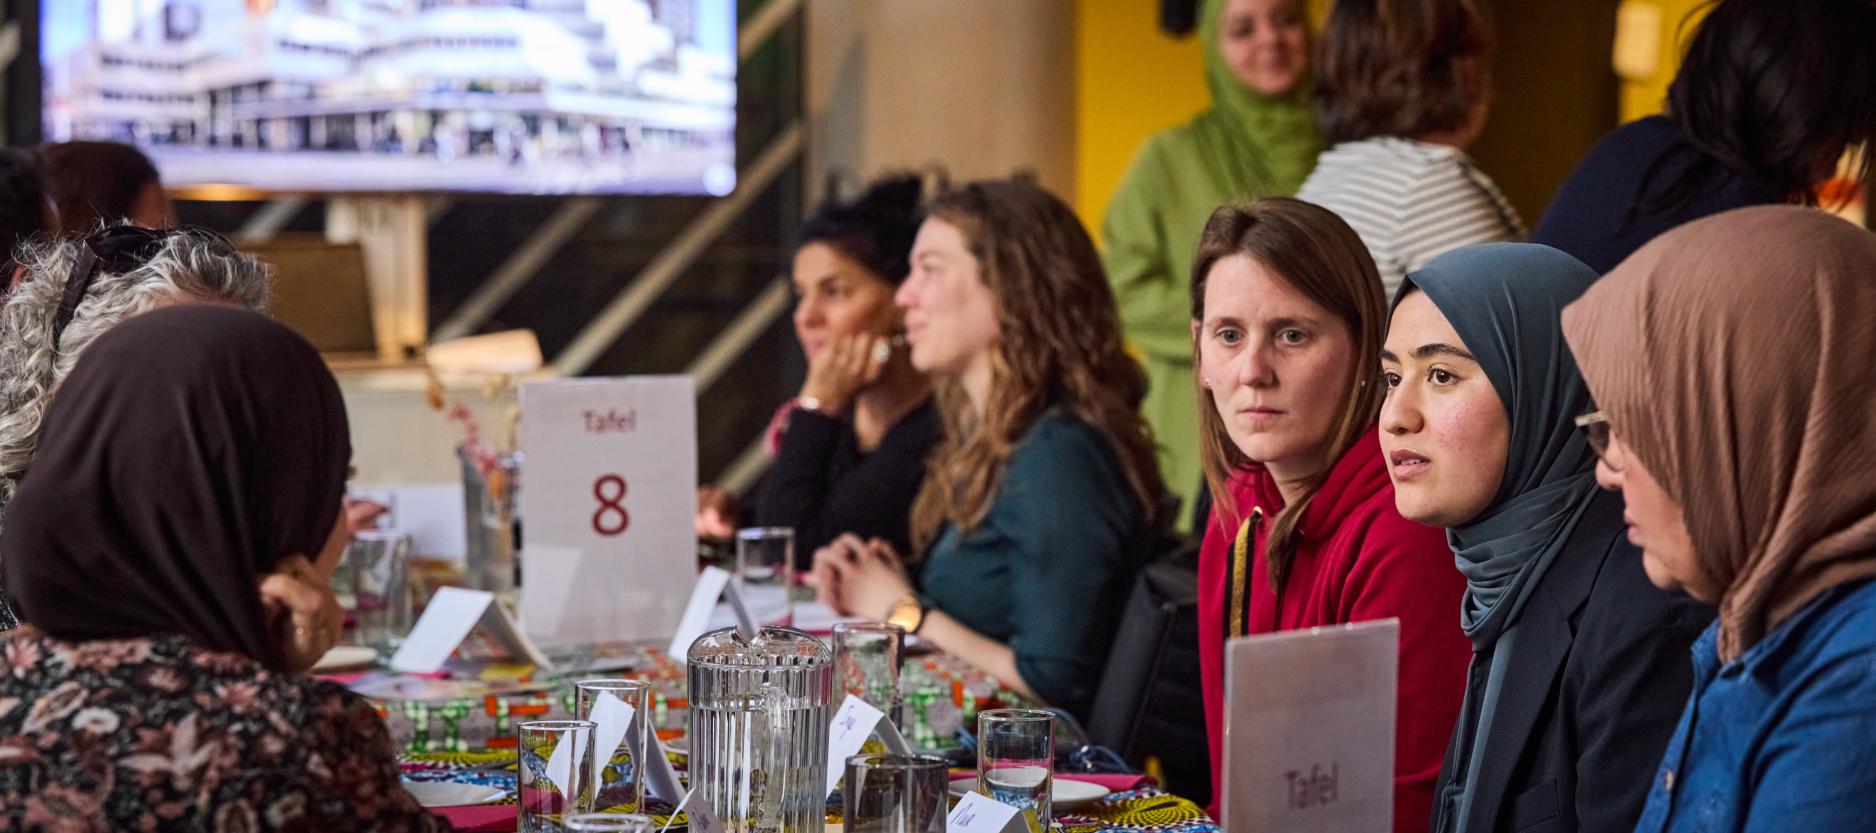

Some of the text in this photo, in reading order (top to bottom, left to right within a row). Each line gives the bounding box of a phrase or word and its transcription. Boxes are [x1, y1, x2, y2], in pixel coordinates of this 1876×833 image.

[581, 408, 636, 432] Tafel
[592, 473, 629, 537] 8
[1285, 762, 1338, 810] Tafel
